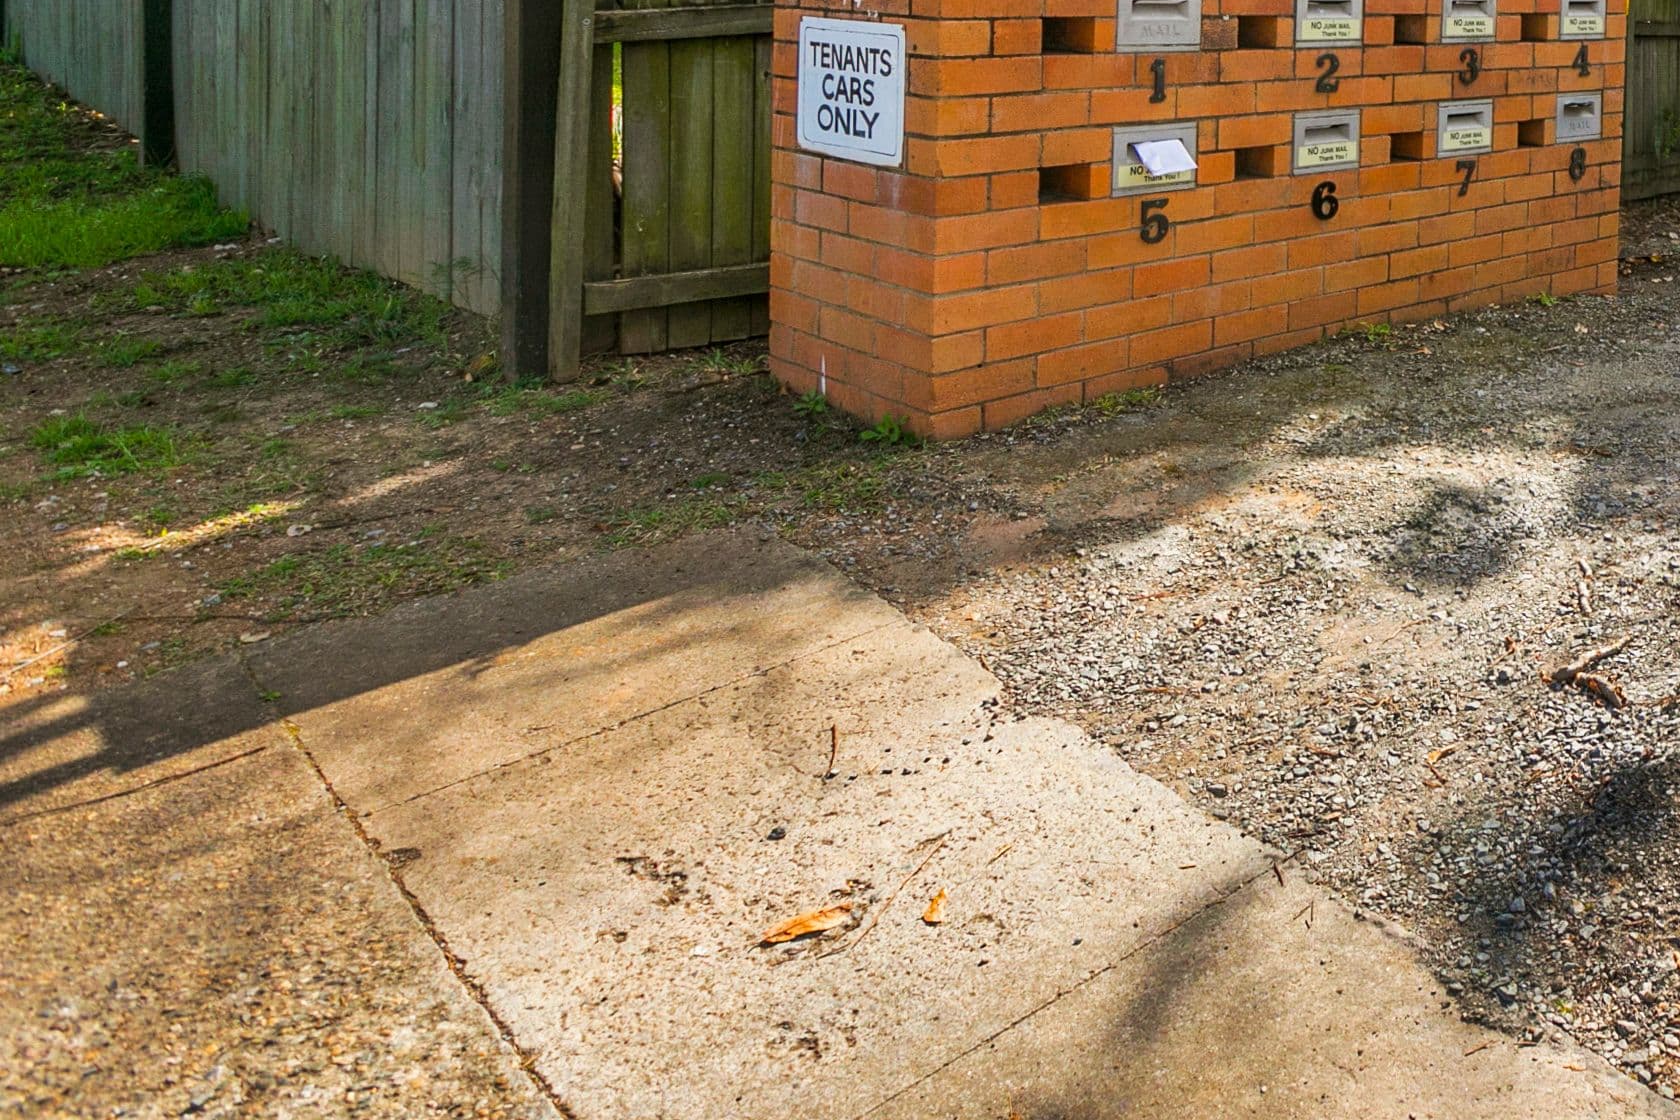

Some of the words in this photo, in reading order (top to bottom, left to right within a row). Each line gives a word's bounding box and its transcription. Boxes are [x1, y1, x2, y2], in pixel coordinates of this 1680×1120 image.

[1311, 21, 1322, 30] NO
[1323, 22, 1337, 30] JUNK
[1453, 18, 1463, 27] NO
[809, 40, 892, 77] TENANTS
[1315, 53, 1340, 93] 2
[1459, 48, 1478, 87] 3
[1572, 44, 1591, 78] 4
[821, 73, 875, 106] CARS
[1148, 57, 1167, 105] 1
[817, 103, 880, 139] ONLY
[1449, 132, 1460, 140] NO
[1307, 146, 1319, 155] NO
[1568, 147, 1587, 182] 8
[1129, 165, 1144, 176] NO
[1456, 160, 1476, 197] 7
[1311, 180, 1339, 220] 6
[1140, 197, 1170, 245] 5
